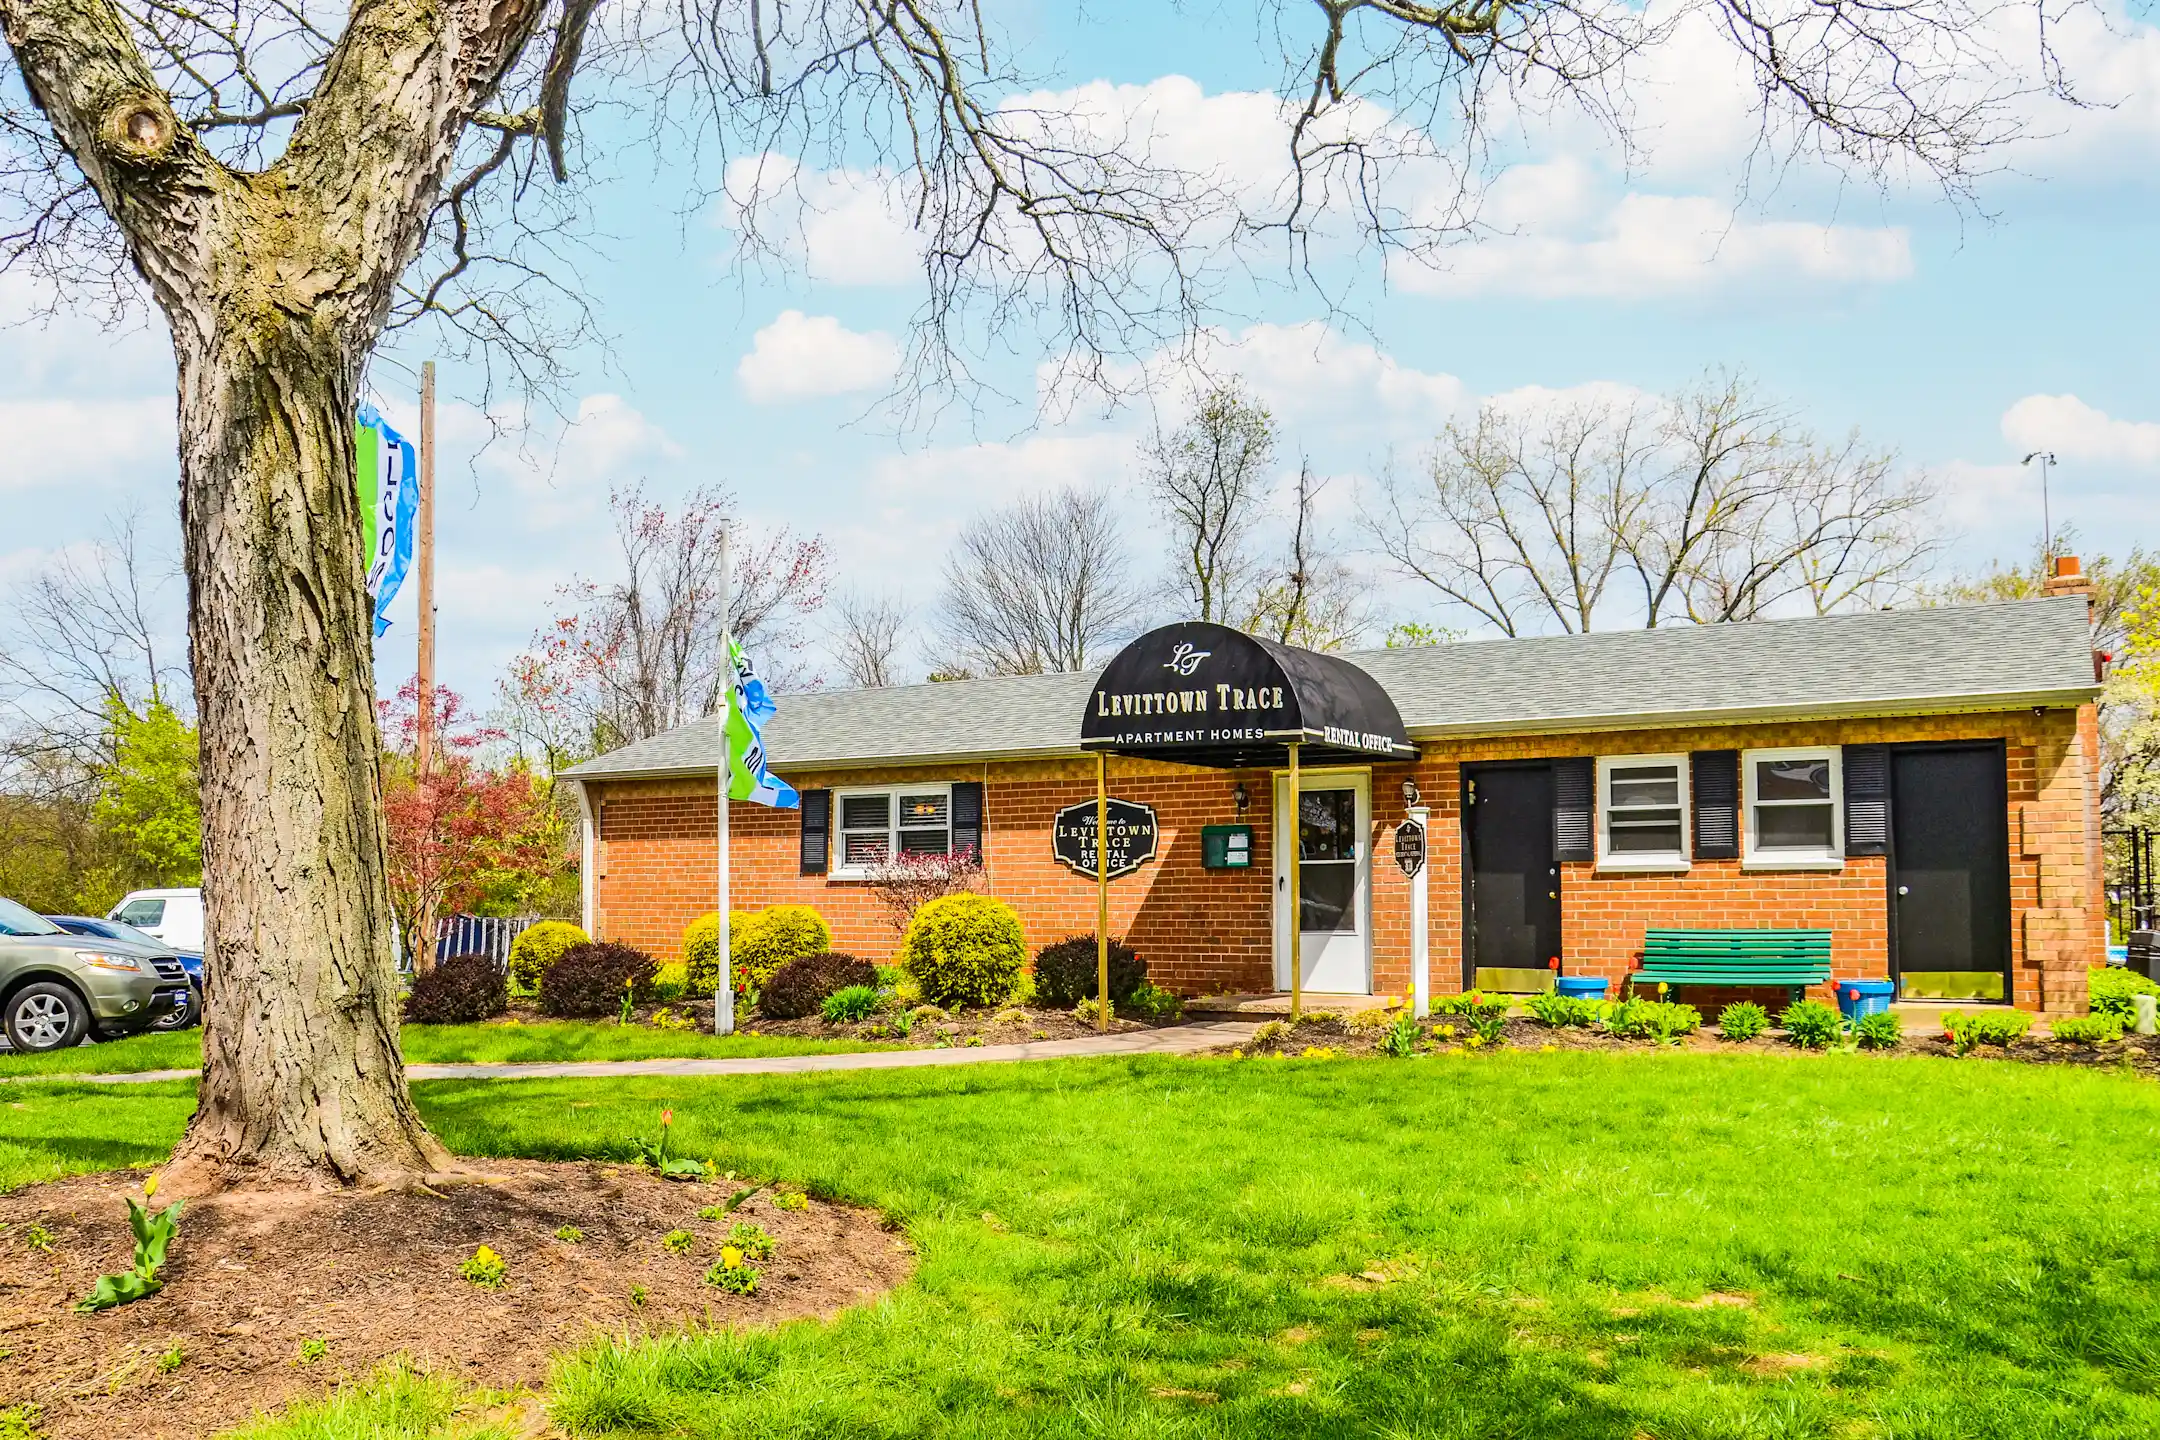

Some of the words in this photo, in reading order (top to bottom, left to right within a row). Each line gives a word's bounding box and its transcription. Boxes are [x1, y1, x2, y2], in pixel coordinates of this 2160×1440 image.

[1097, 690, 1208, 717] LEVITTOWN
[1216, 683, 1284, 711] TRACE
[1116, 730, 1205, 744] APARTMENT
[1211, 728, 1264, 740] HOMES
[1324, 726, 1361, 748] RENTAL
[1361, 732, 1393, 753] OFFICE
[1059, 825, 1151, 837] LEVITOWN
[1081, 850, 1128, 858] RETAL
[1082, 859, 1126, 867] OFICE
